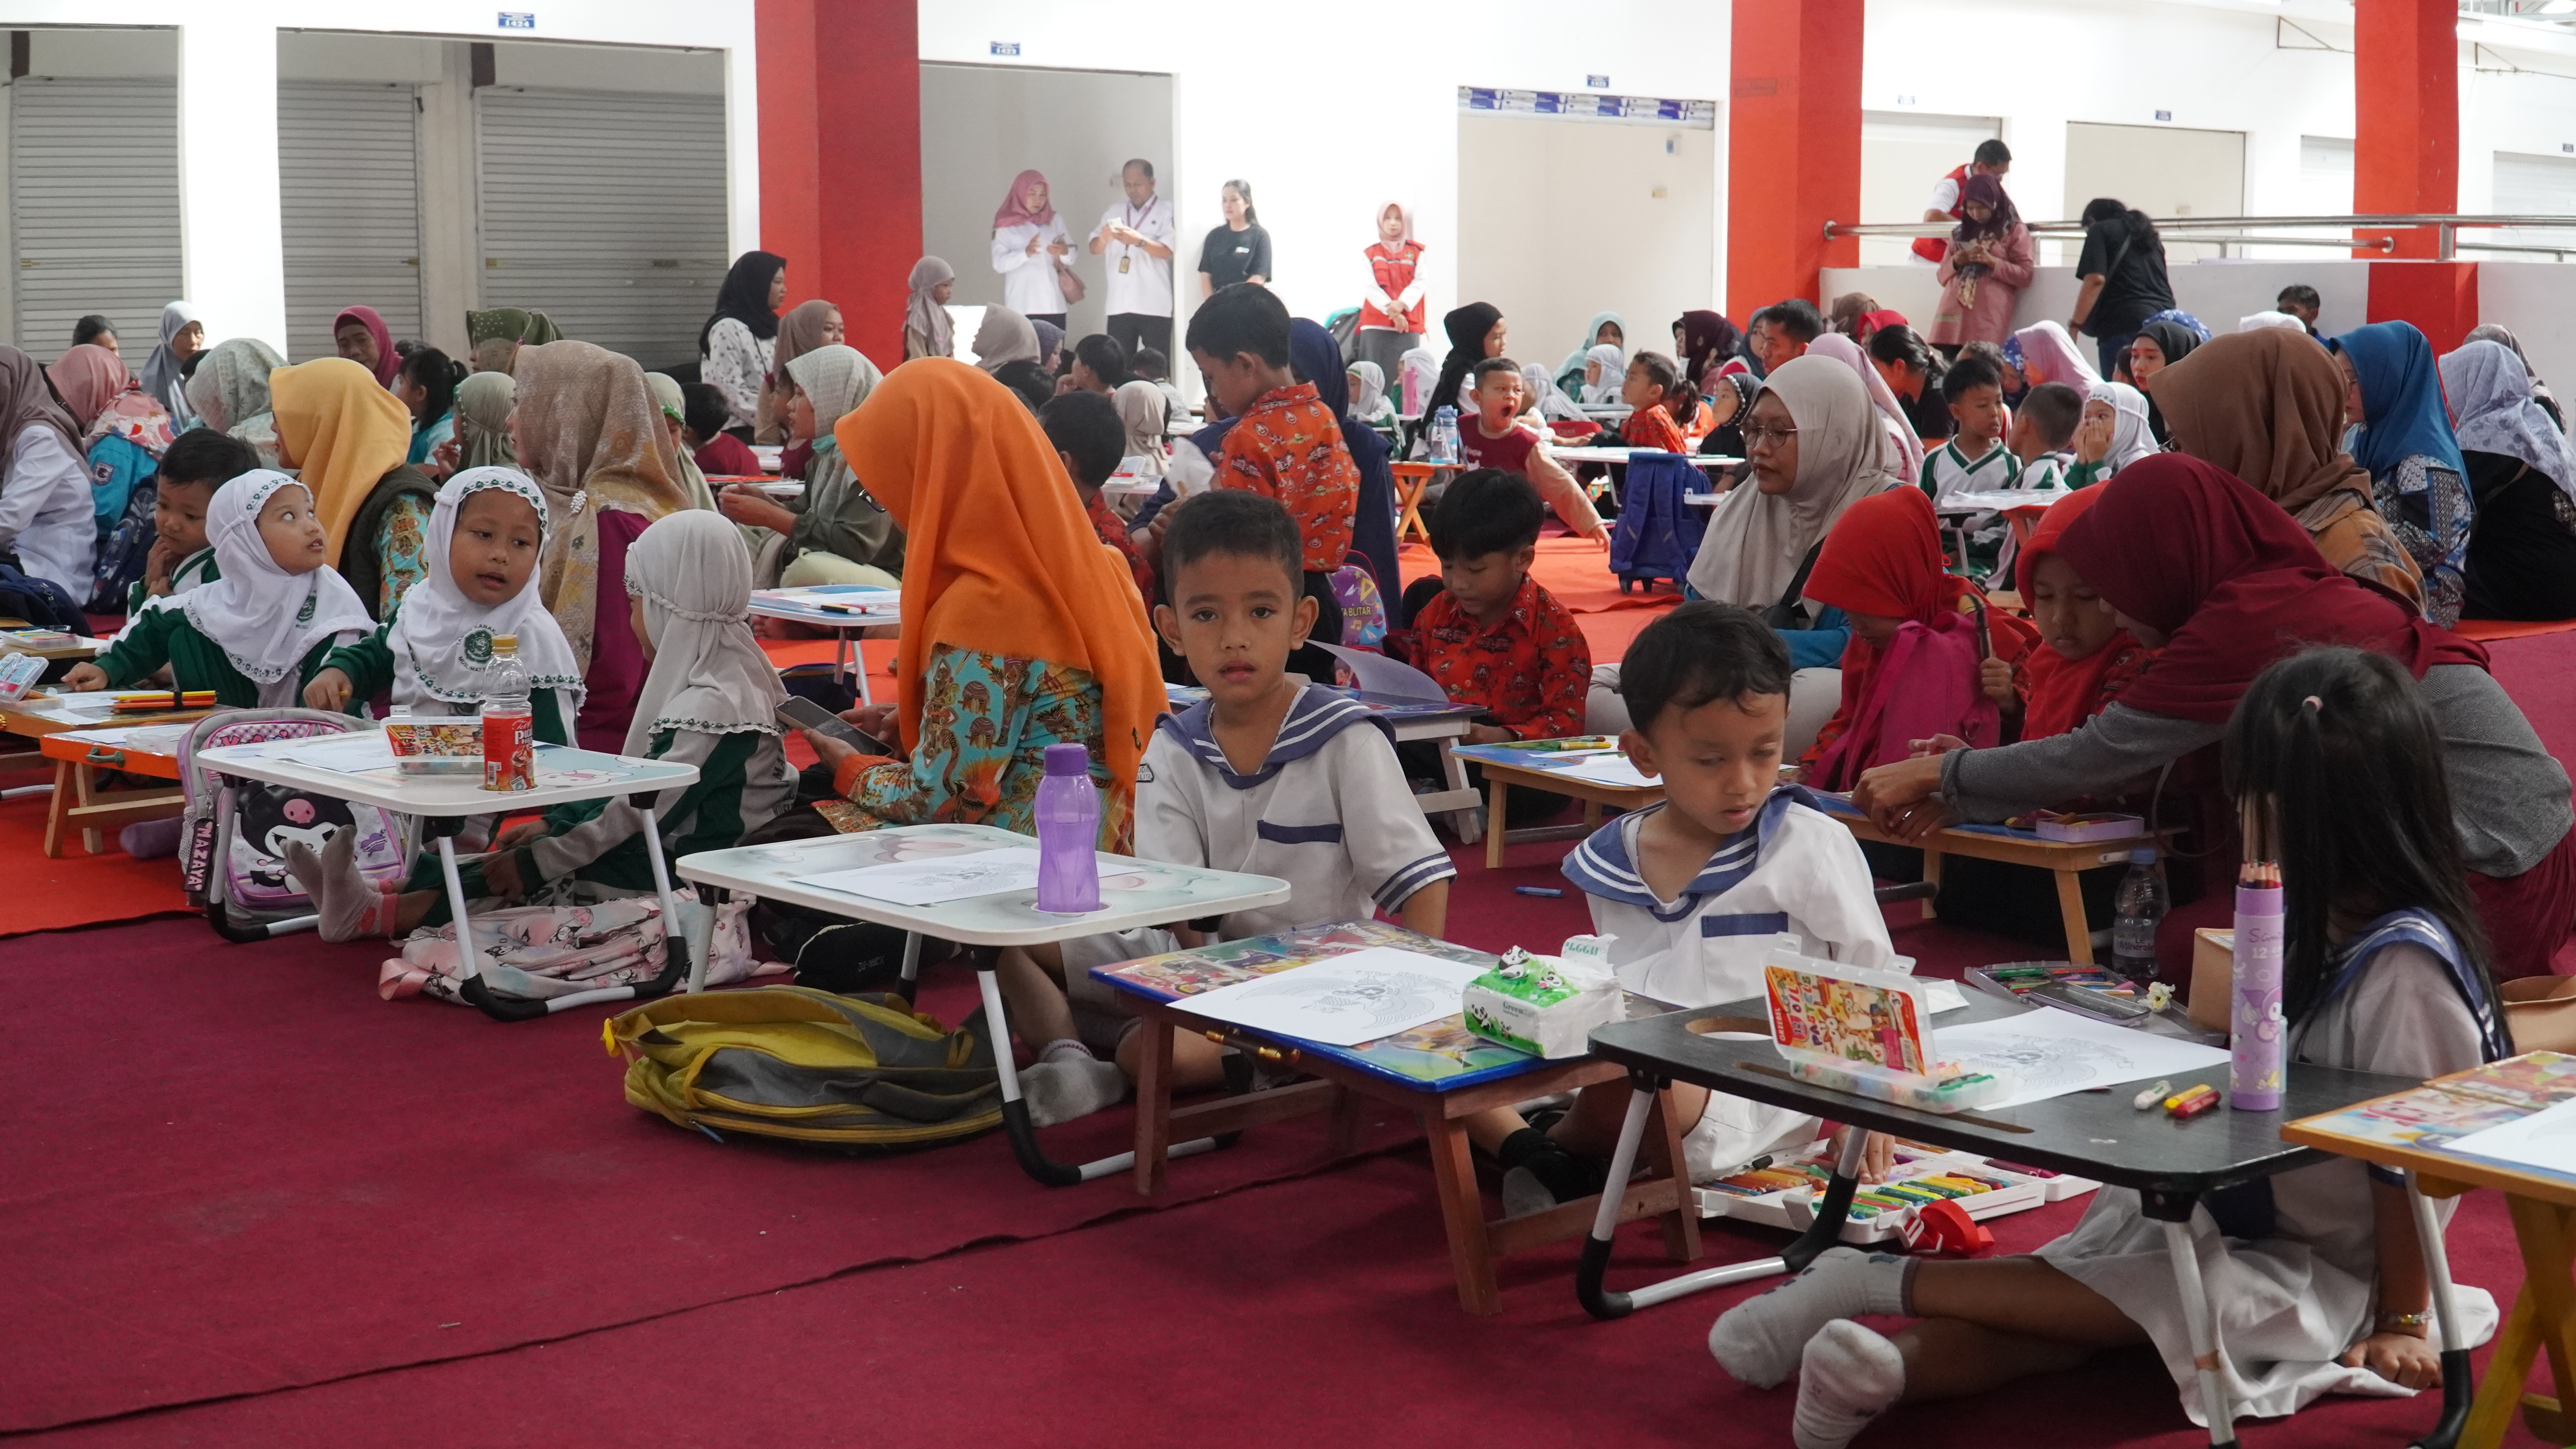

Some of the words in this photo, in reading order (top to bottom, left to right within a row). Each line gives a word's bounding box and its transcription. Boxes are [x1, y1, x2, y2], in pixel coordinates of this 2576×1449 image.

[1349, 606, 1371, 616] BLITAR
[188, 827, 213, 885] MAZAYA
[1503, 1001, 1523, 1014] Green
[1788, 987, 1802, 1013] OIL
[1775, 1008, 1786, 1041] GREEBEL
[1792, 1022, 1802, 1034] 12
